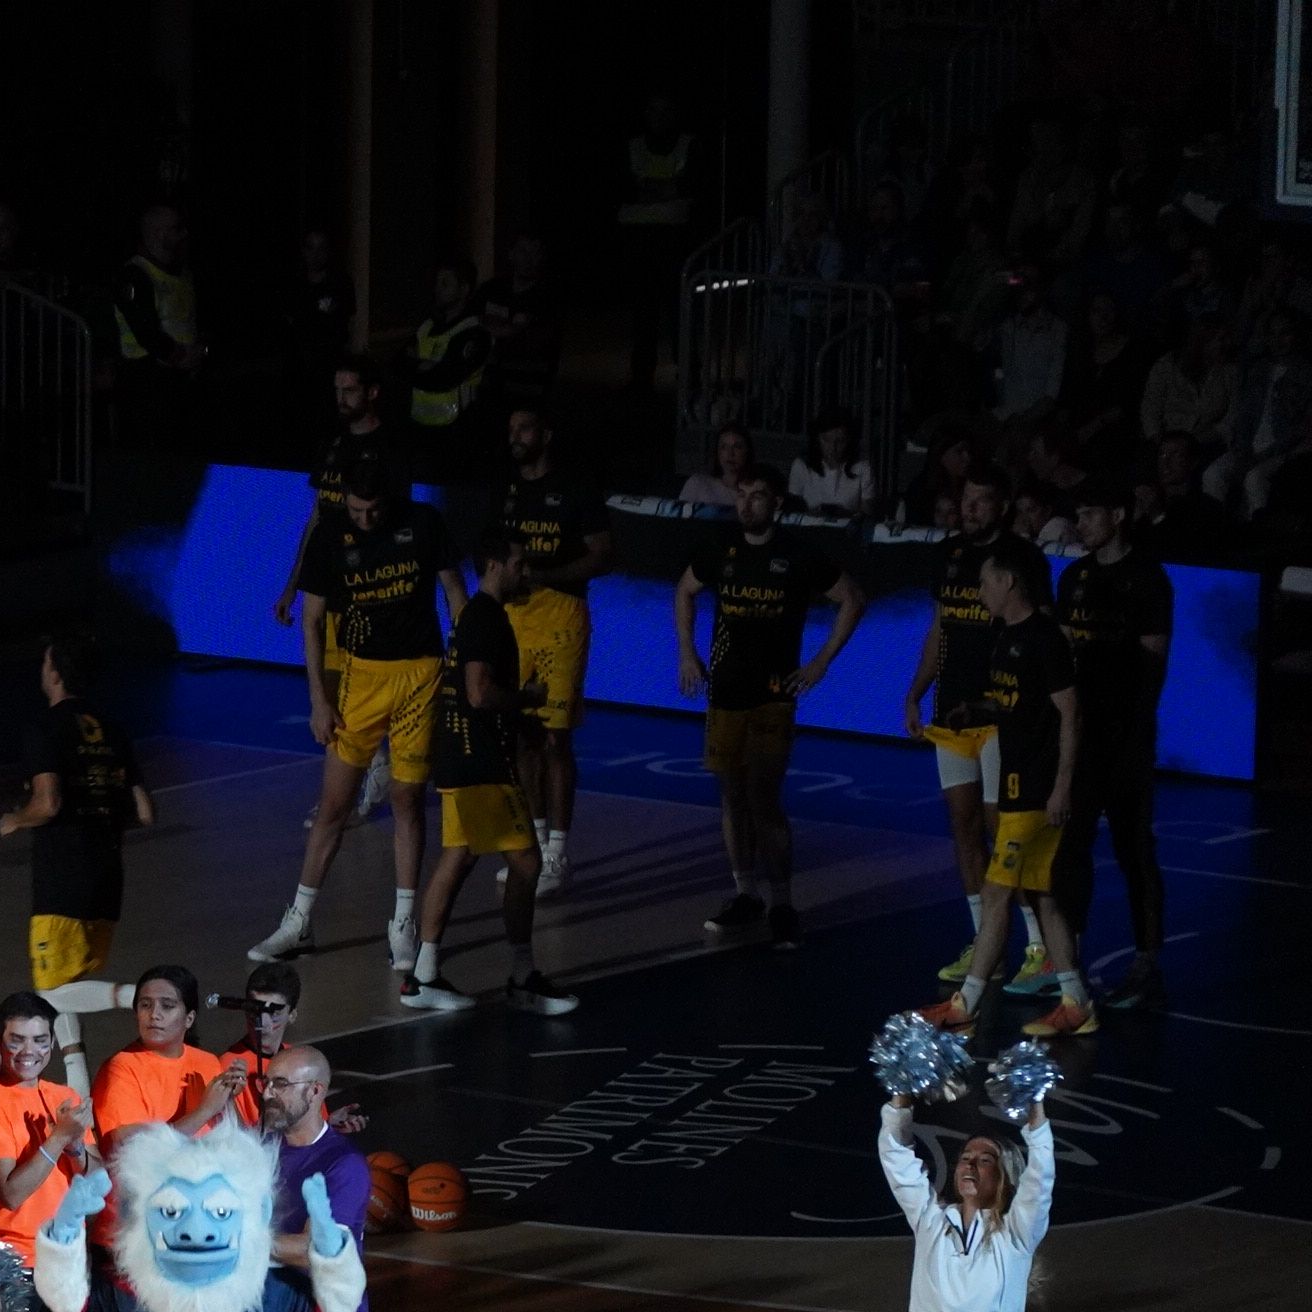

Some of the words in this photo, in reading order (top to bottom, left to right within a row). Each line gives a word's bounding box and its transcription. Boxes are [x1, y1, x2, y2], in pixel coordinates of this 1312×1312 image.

[344, 573, 363, 586] LA
[365, 560, 420, 583] LAGUNA
[611, 1060, 859, 1170] MOLINES
[410, 1205, 457, 1221] Wilson
